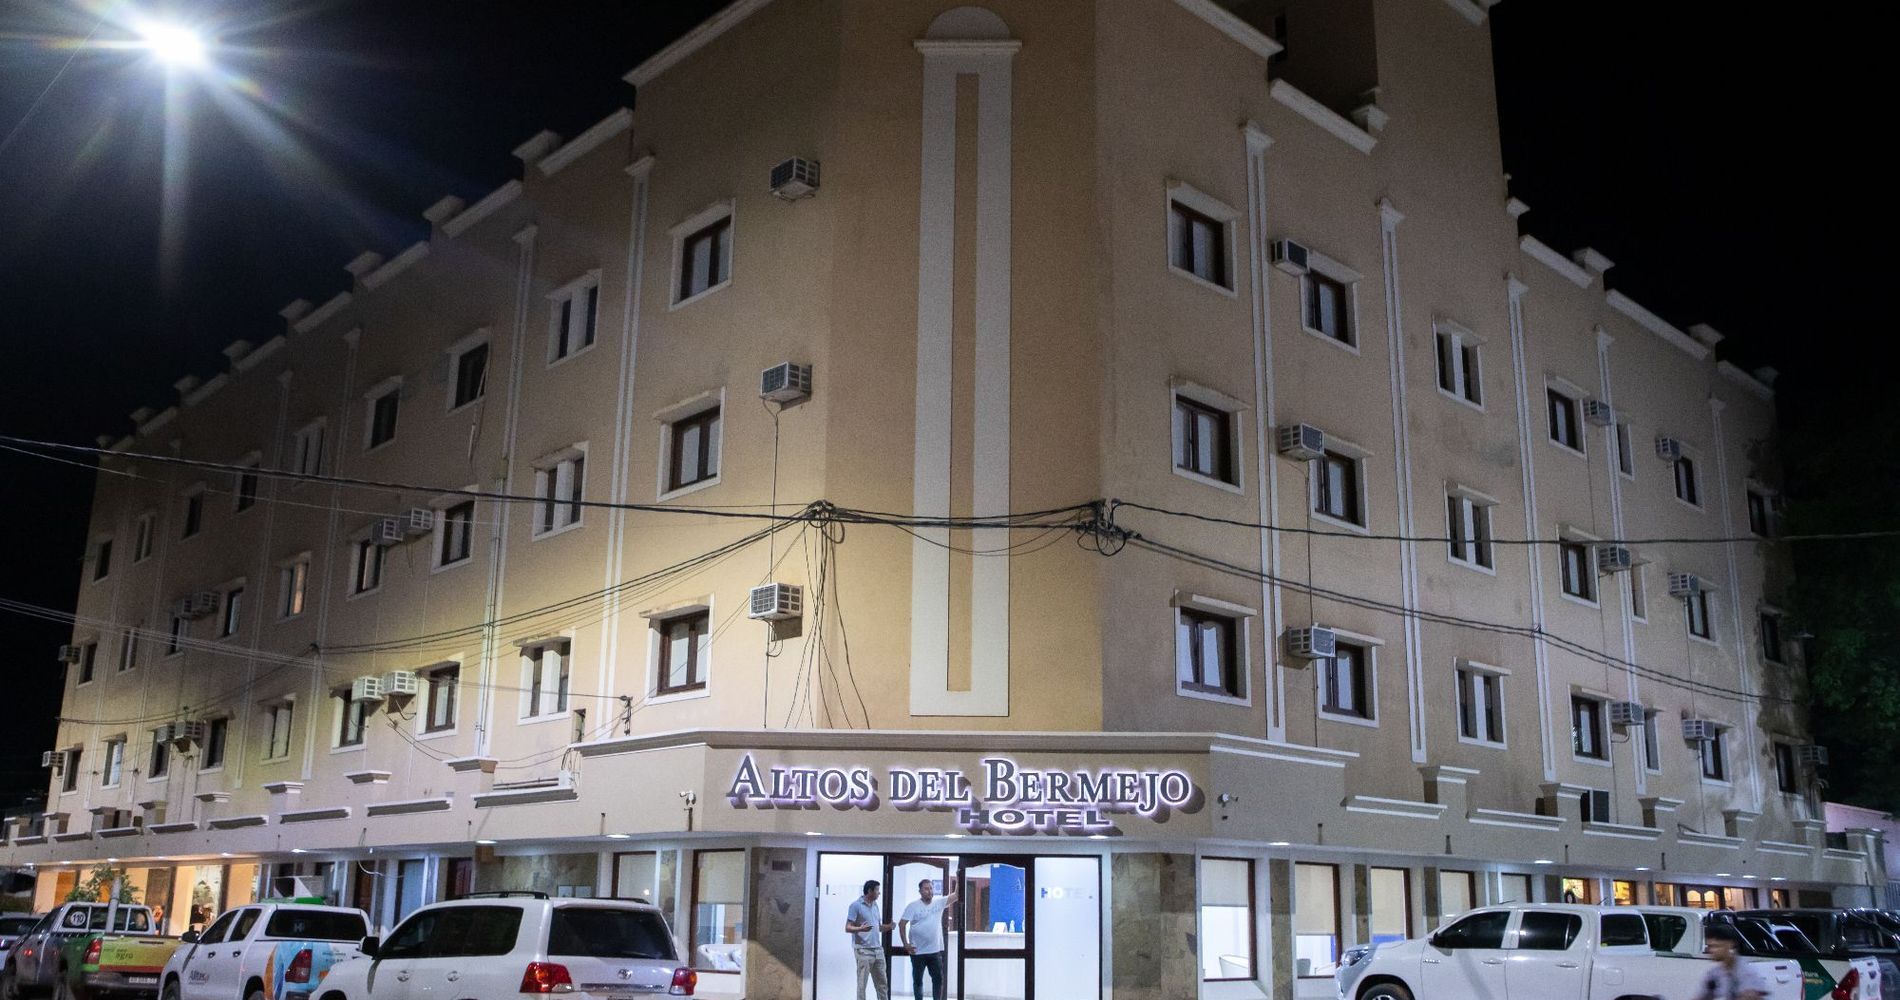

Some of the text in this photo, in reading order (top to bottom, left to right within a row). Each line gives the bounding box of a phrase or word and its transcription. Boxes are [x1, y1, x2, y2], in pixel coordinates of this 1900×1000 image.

[726, 754, 1191, 812] ALTOS DEL BERMEJO
[959, 808, 1110, 826] HOTEL
